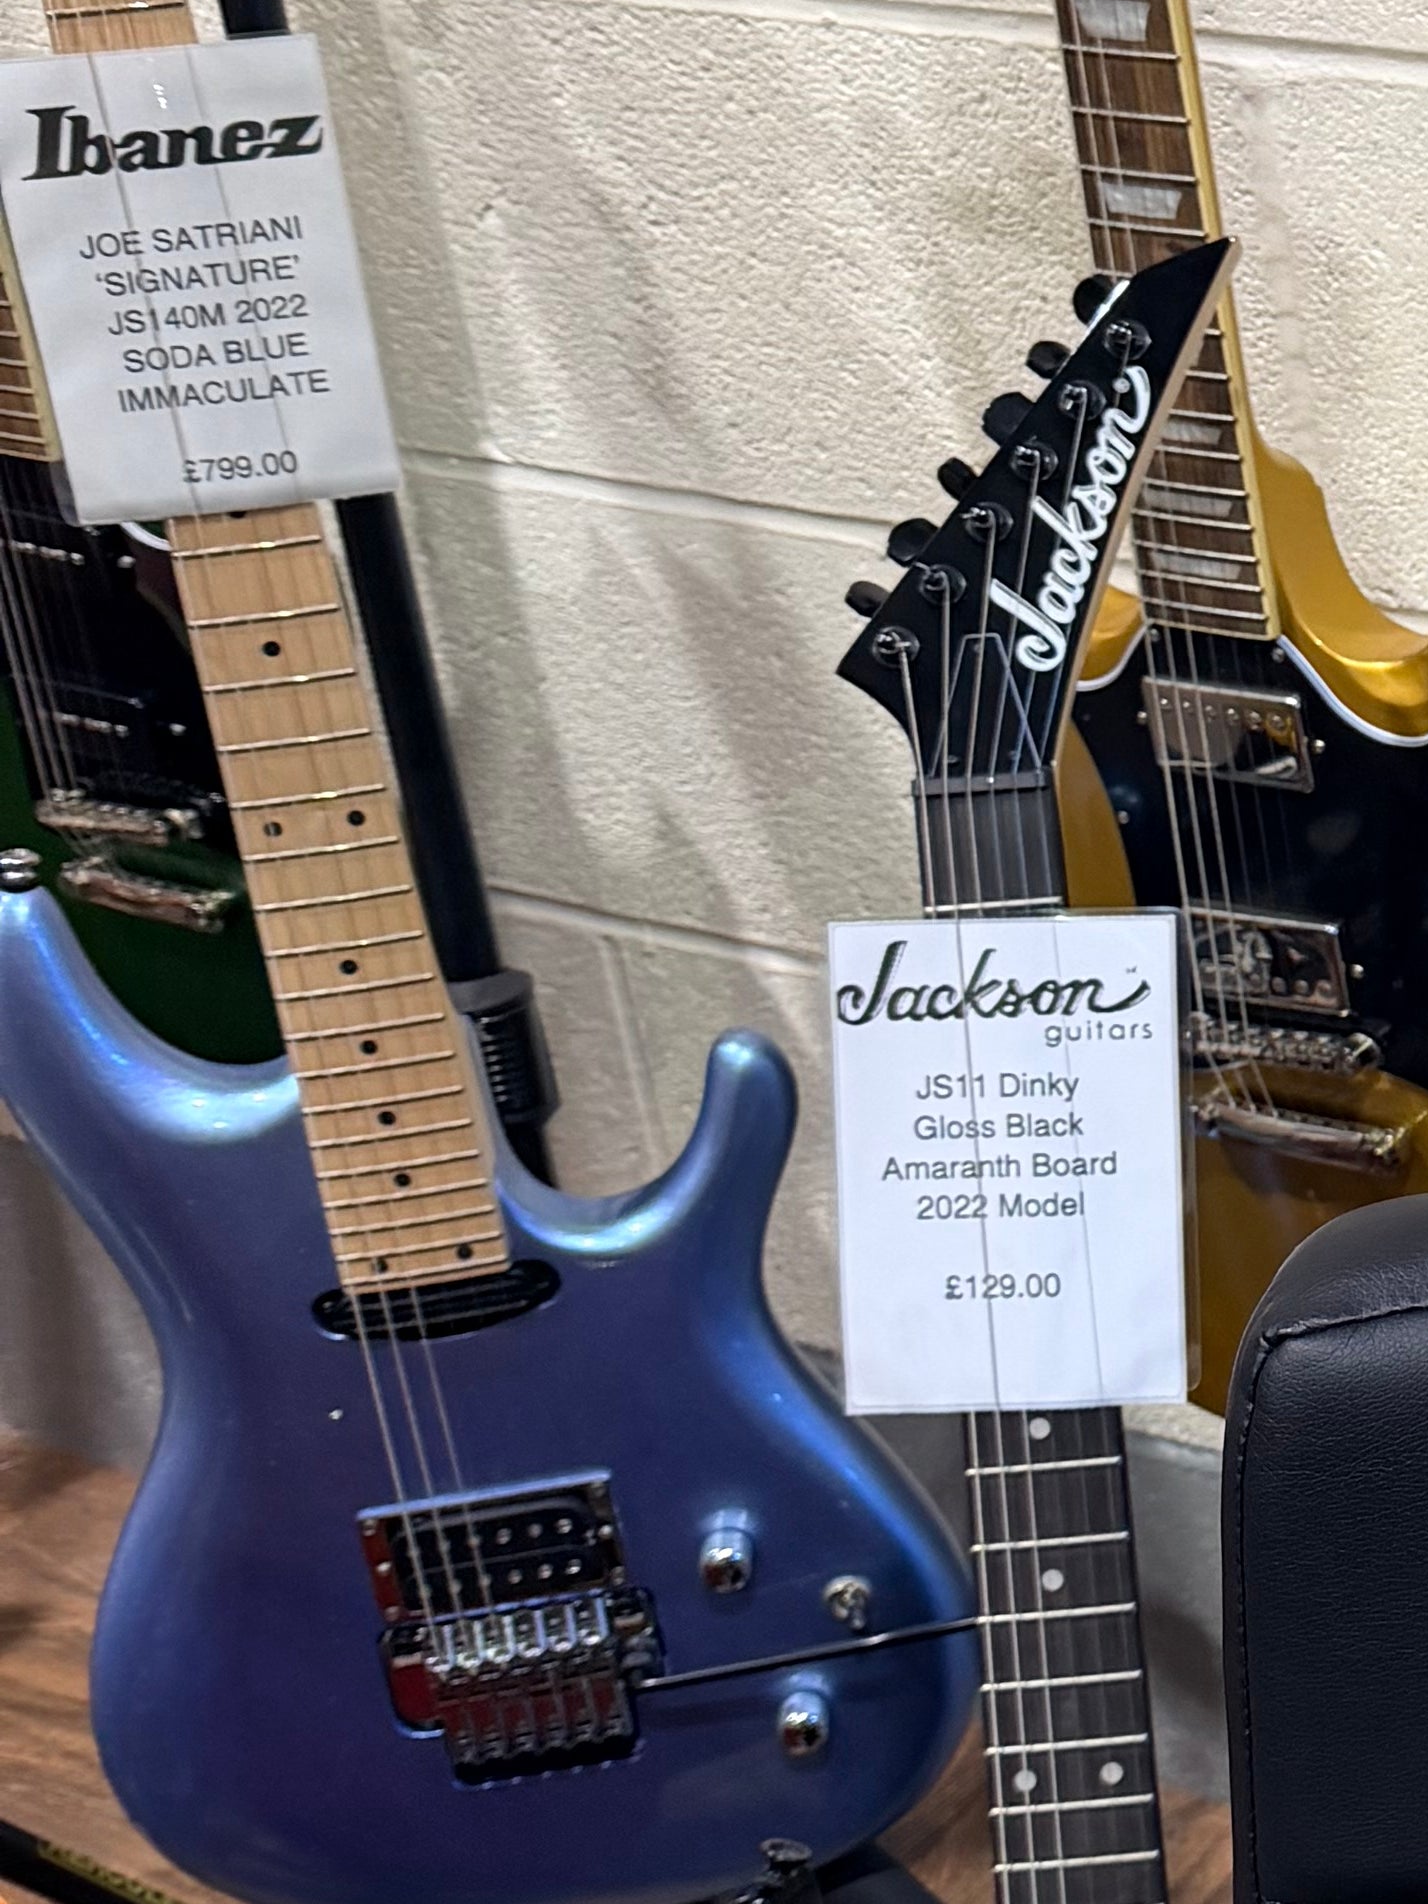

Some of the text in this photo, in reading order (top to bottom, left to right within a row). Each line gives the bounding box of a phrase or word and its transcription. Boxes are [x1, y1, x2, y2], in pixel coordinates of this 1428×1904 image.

[21, 104, 325, 181] Ibanez
[79, 214, 304, 261] JOE SATRIANI
[108, 293, 310, 336] JS140M 2022
[123, 332, 310, 375] SODA BLUE
[118, 369, 331, 414] IMMACULATE
[182, 449, 299, 484] £799.00
[990, 364, 1153, 673] Jackson
[836, 940, 1151, 1026] Jackson
[1044, 1020, 1153, 1047] guitars
[916, 1071, 1080, 1100] JS11 Dinky
[913, 1112, 1084, 1141] Gloss Black
[882, 1151, 1117, 1182] Amaranth Board
[917, 1191, 1085, 1220] 2022 Model
[945, 1271, 1061, 1300] £129.00
